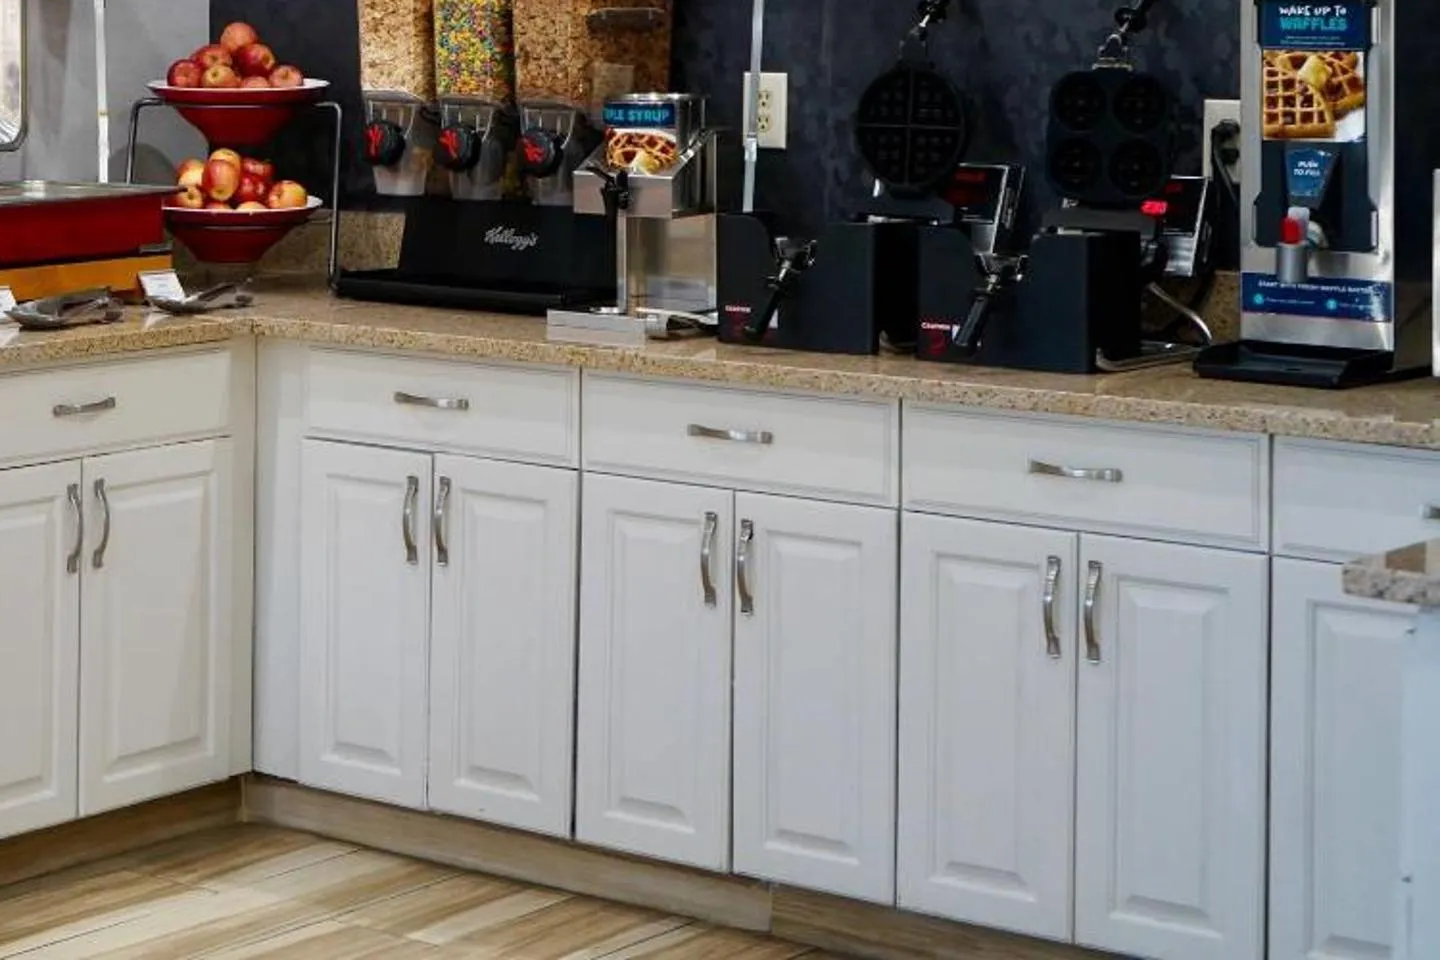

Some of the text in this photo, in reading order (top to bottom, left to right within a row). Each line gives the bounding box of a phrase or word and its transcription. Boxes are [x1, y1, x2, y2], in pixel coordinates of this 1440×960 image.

[1278, 4, 1311, 16] WAKE
[1314, 5, 1332, 16] UP
[1279, 16, 1348, 31] WAFFLES
[627, 108, 670, 122] SYRUP
